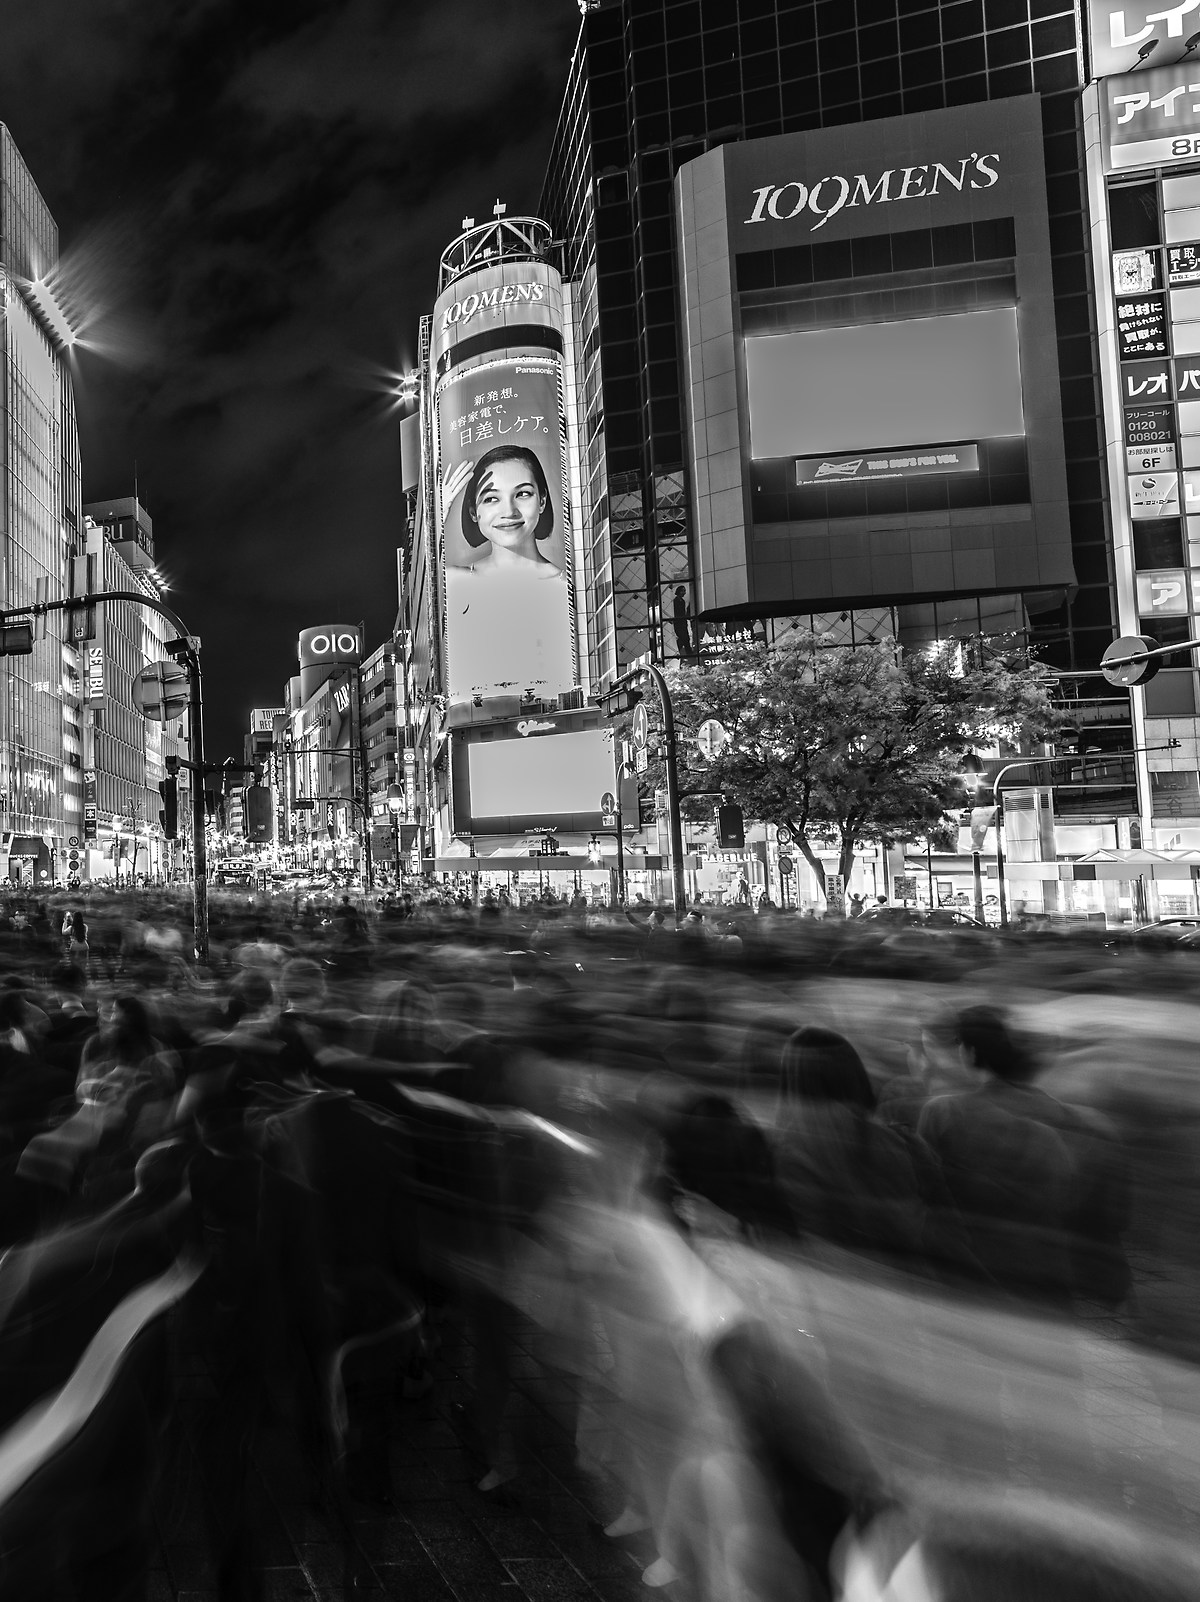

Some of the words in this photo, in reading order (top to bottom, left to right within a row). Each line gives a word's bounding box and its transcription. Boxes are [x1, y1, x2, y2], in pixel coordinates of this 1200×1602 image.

[1118, 303, 1162, 318] 絶対に
[1123, 342, 1165, 353] ここにある
[516, 367, 554, 375] Panasonic
[474, 387, 518, 406] 新発想。
[1126, 410, 1170, 419] フリーコール
[460, 416, 549, 447] 日差しケア。
[1128, 421, 1156, 431] 0120
[1129, 431, 1171, 442] 008021
[1128, 446, 1173, 455] お部屋探しは
[1142, 457, 1161, 469] 6F
[89, 647, 103, 698] SEIBU
[334, 683, 350, 712] ZAR
